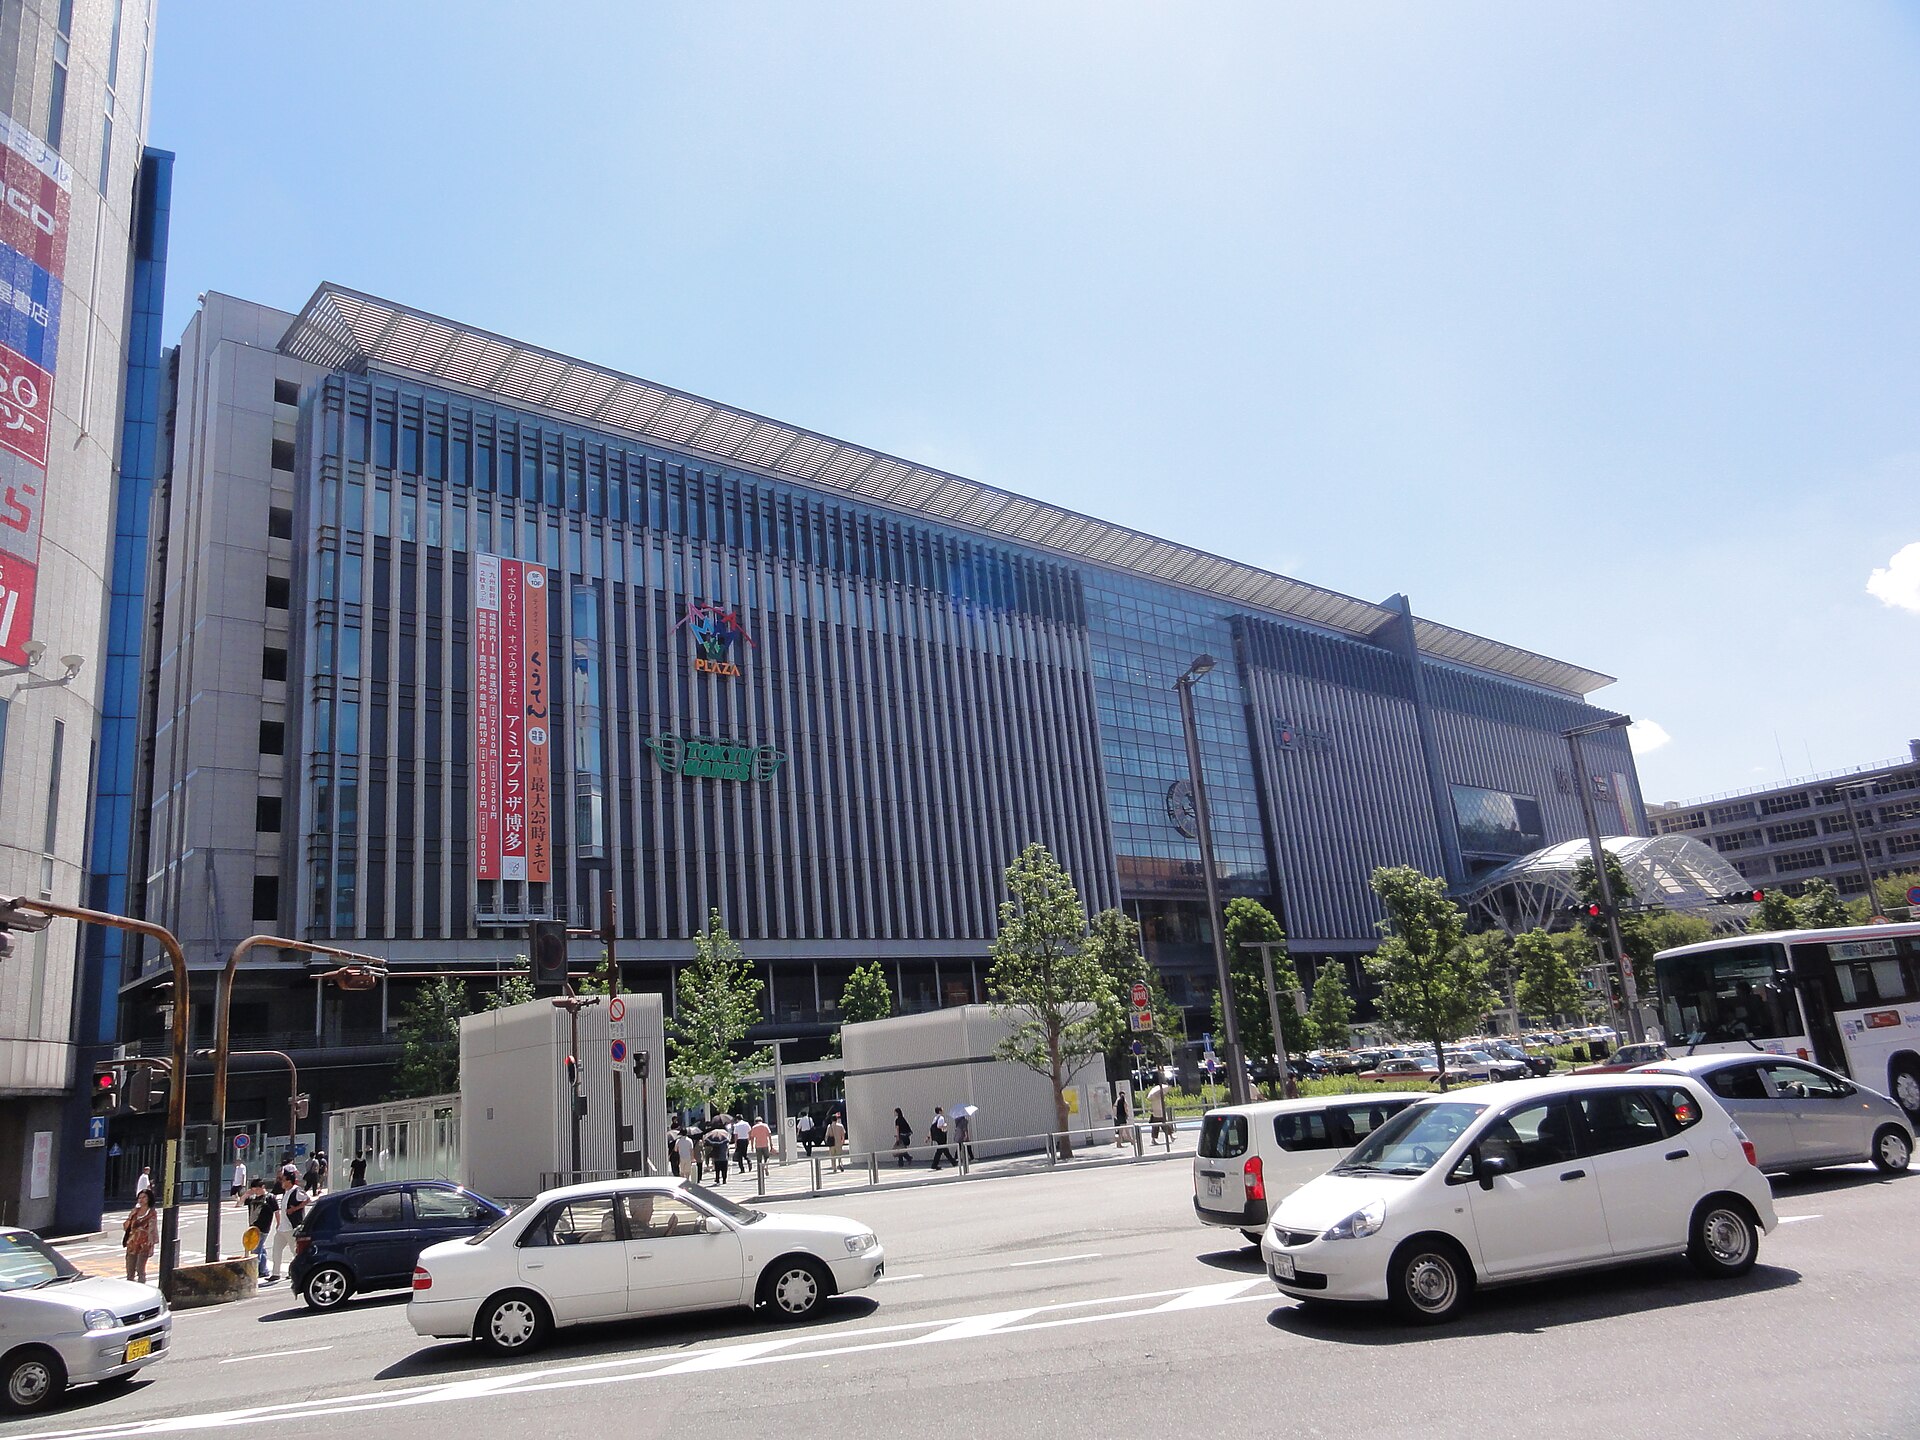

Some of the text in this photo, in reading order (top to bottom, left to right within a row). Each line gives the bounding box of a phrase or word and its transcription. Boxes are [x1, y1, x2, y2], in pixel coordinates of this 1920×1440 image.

[528, 651, 547, 719] くうてん
[695, 657, 741, 677] PLAZA
[504, 714, 523, 852] アミュプラザ博多
